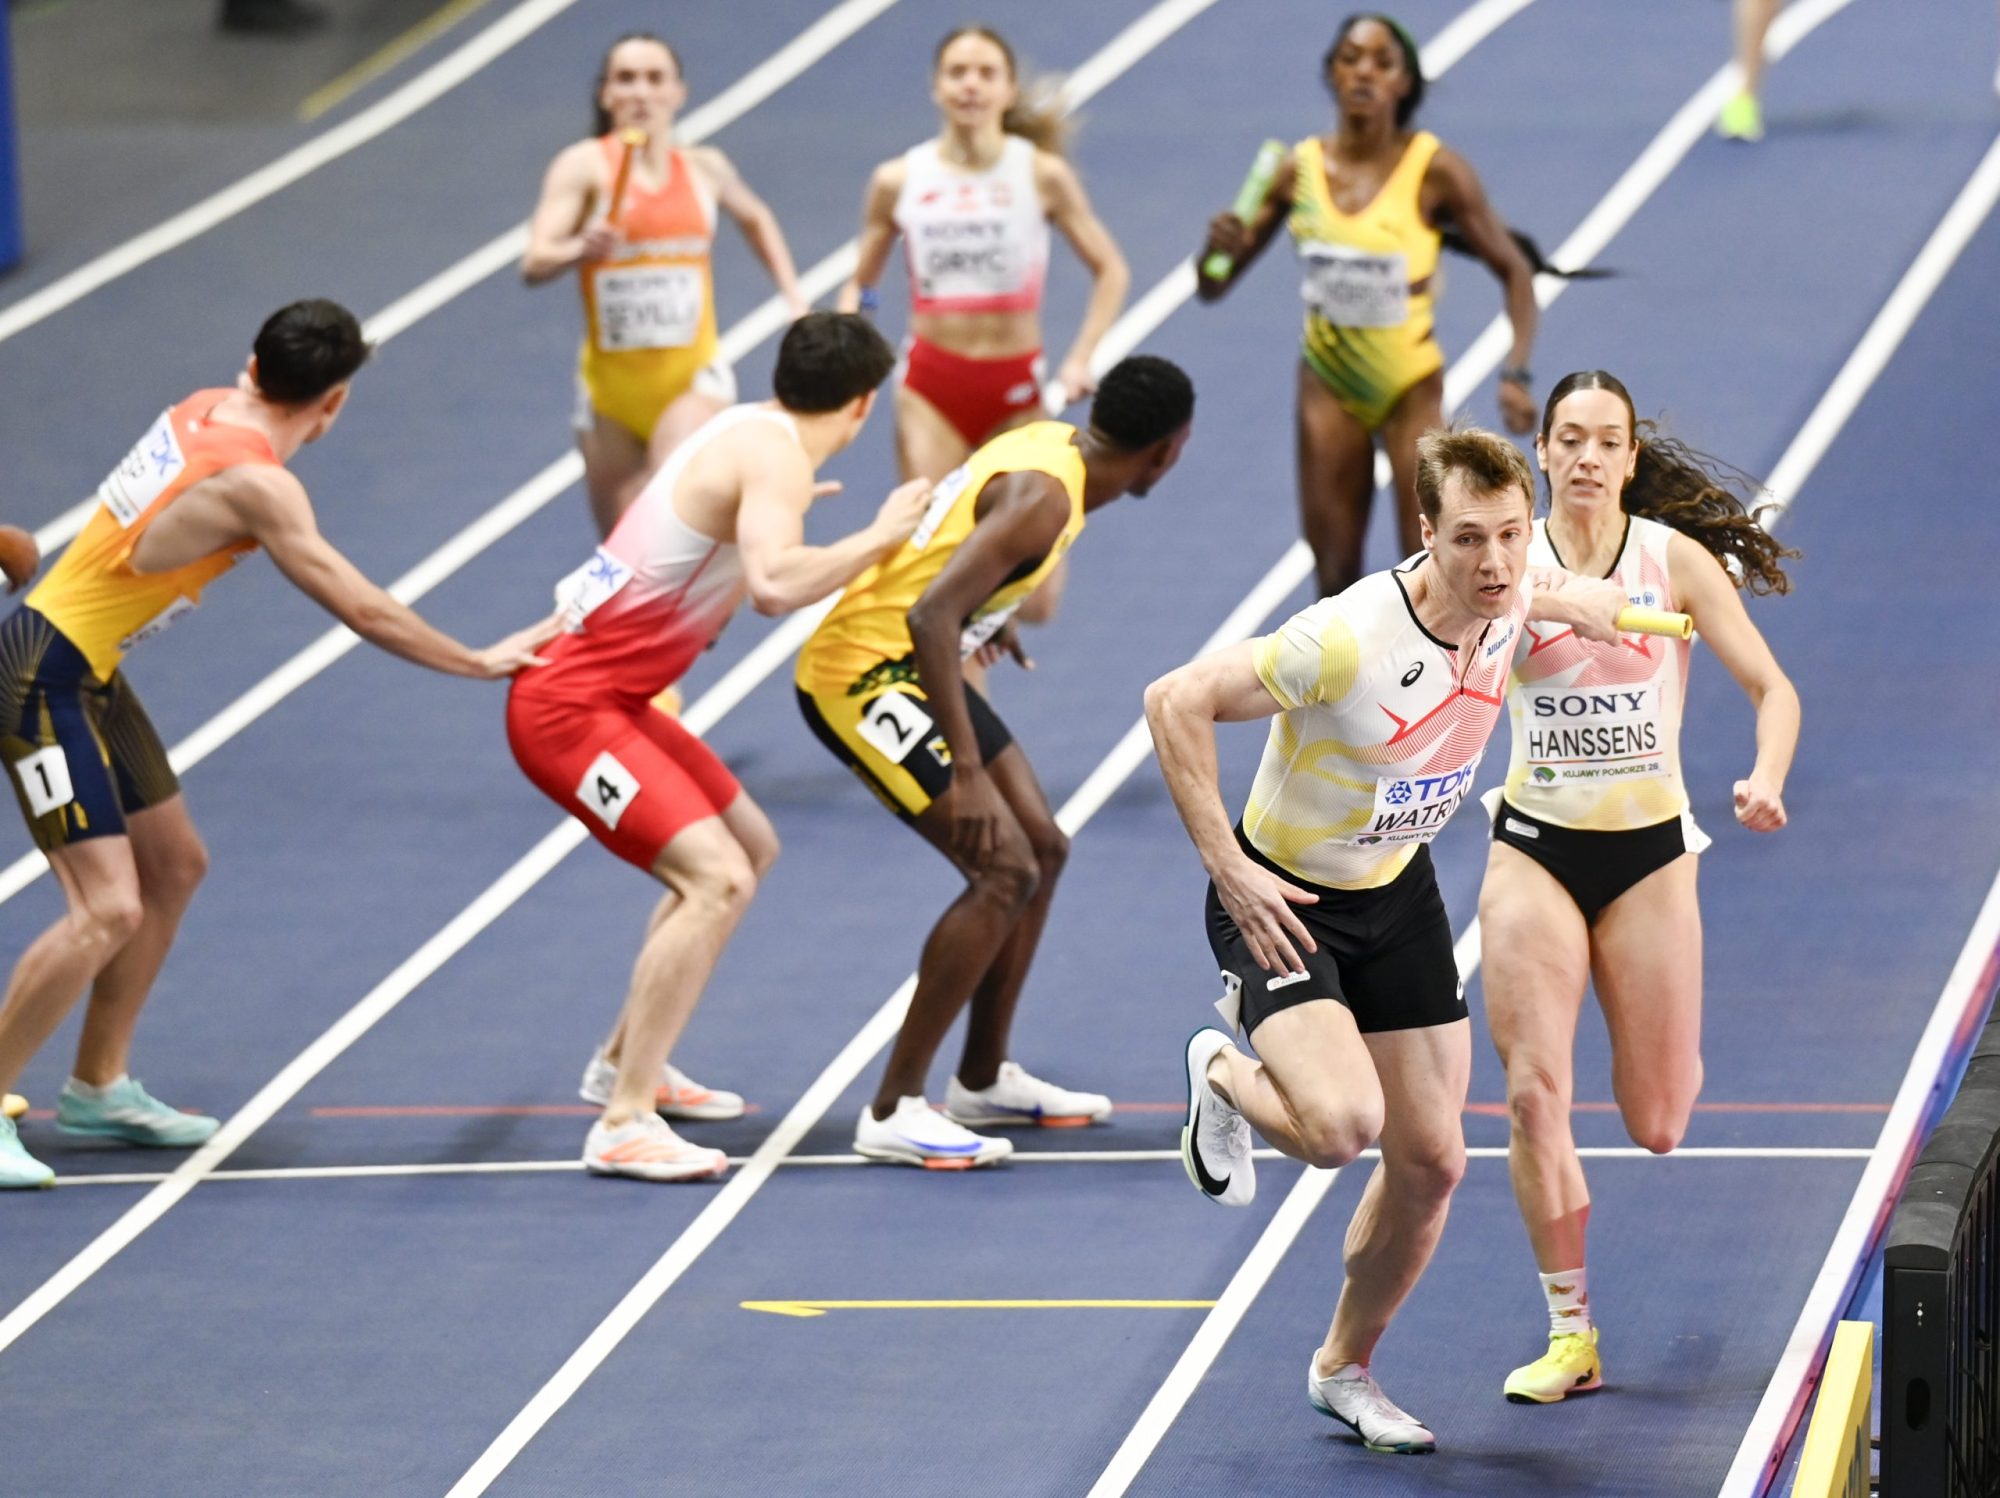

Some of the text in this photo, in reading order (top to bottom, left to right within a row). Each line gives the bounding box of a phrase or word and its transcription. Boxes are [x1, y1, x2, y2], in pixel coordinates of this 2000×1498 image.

[1534, 690, 1646, 717] SONY
[875, 712, 913, 745] 2
[1529, 721, 1656, 758] HANSSENS
[35, 762, 53, 800] 1
[1415, 760, 1475, 801] TDK
[1562, 769, 1600, 778] KUJAWY
[1602, 764, 1646, 777] POMORZE
[597, 774, 621, 807] 4
